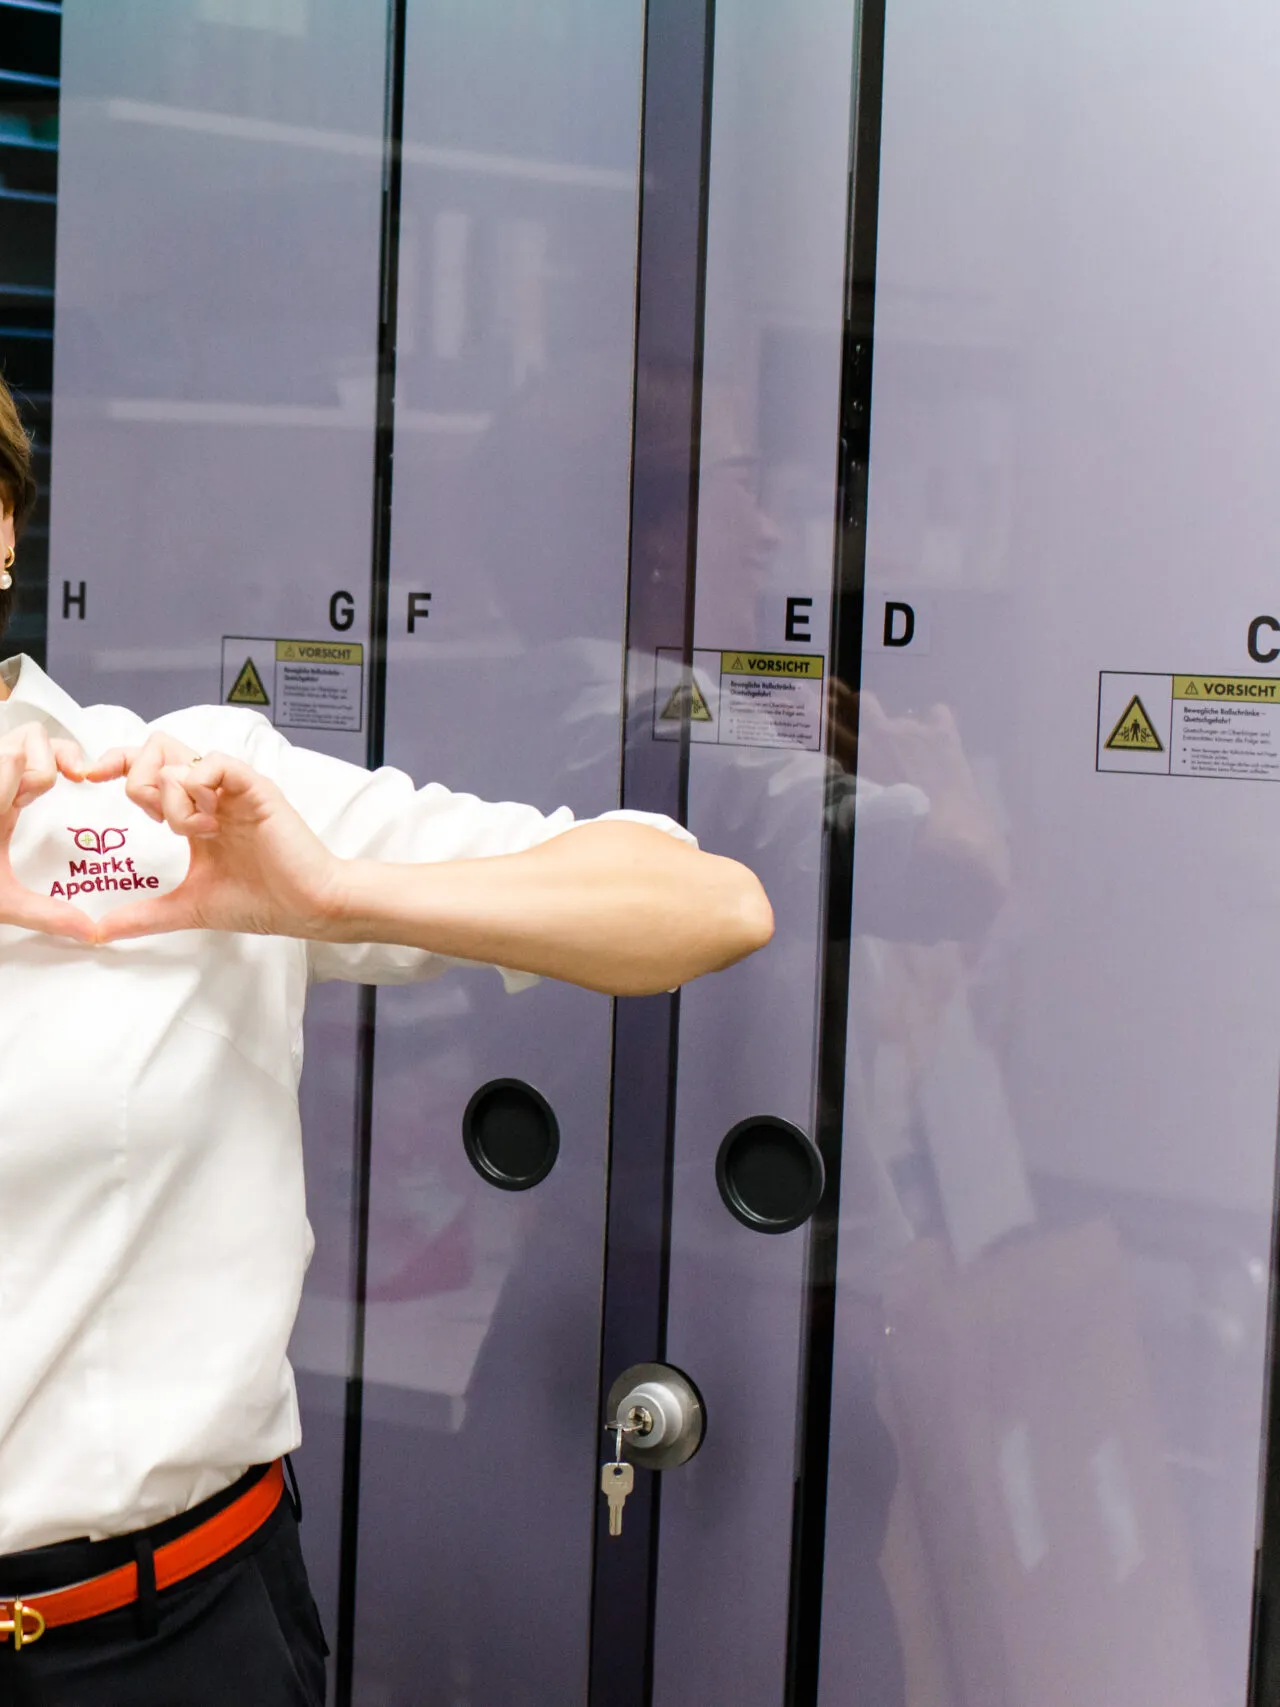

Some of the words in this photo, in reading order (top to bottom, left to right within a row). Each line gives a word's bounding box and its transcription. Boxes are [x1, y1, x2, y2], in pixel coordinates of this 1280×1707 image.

[63, 580, 86, 620] H
[329, 590, 355, 632] G
[407, 592, 432, 634] F
[785, 597, 813, 642] E
[883, 601, 915, 647] D
[298, 647, 352, 660] VORSICHT
[1248, 615, 1280, 663] C
[748, 659, 810, 673] VORSICHT
[1204, 683, 1276, 697] VORSICHT
[1184, 707, 1219, 718] Bewegliche
[68, 857, 135, 877] Markt
[50, 873, 160, 901] Apotheke
